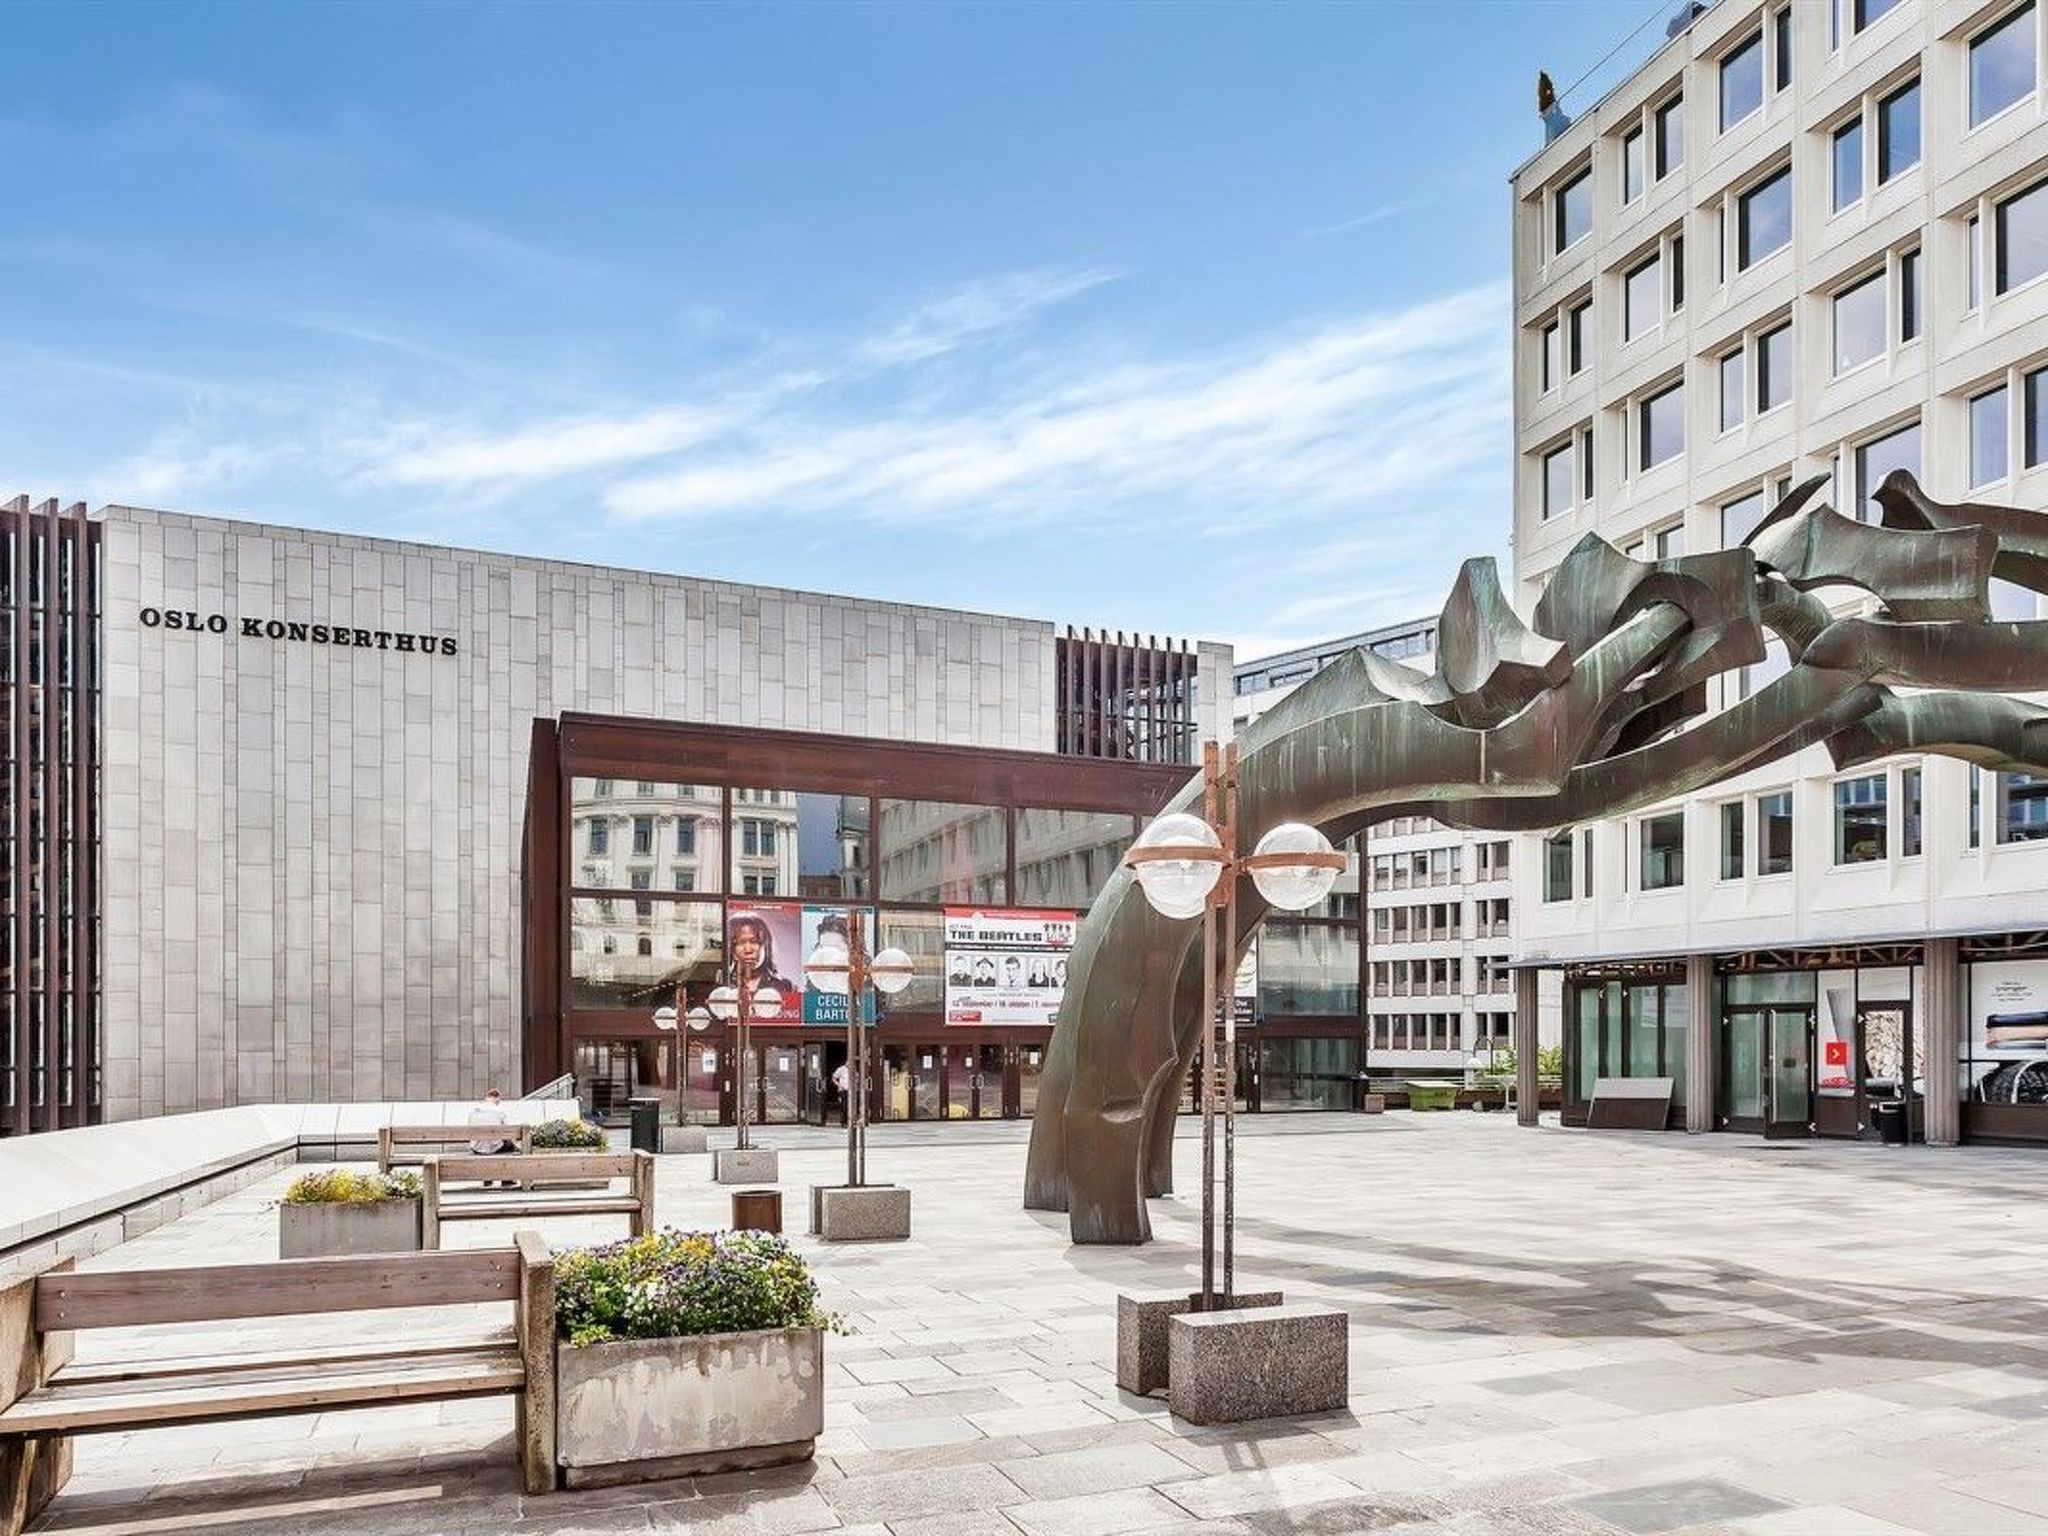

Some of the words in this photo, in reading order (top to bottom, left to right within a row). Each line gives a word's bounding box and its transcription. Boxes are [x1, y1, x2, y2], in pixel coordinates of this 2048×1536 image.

[139, 607, 228, 633] OSLO
[240, 617, 458, 656] KONSERTHUS
[949, 930, 975, 940] THE
[979, 931, 1042, 942] BEATLES
